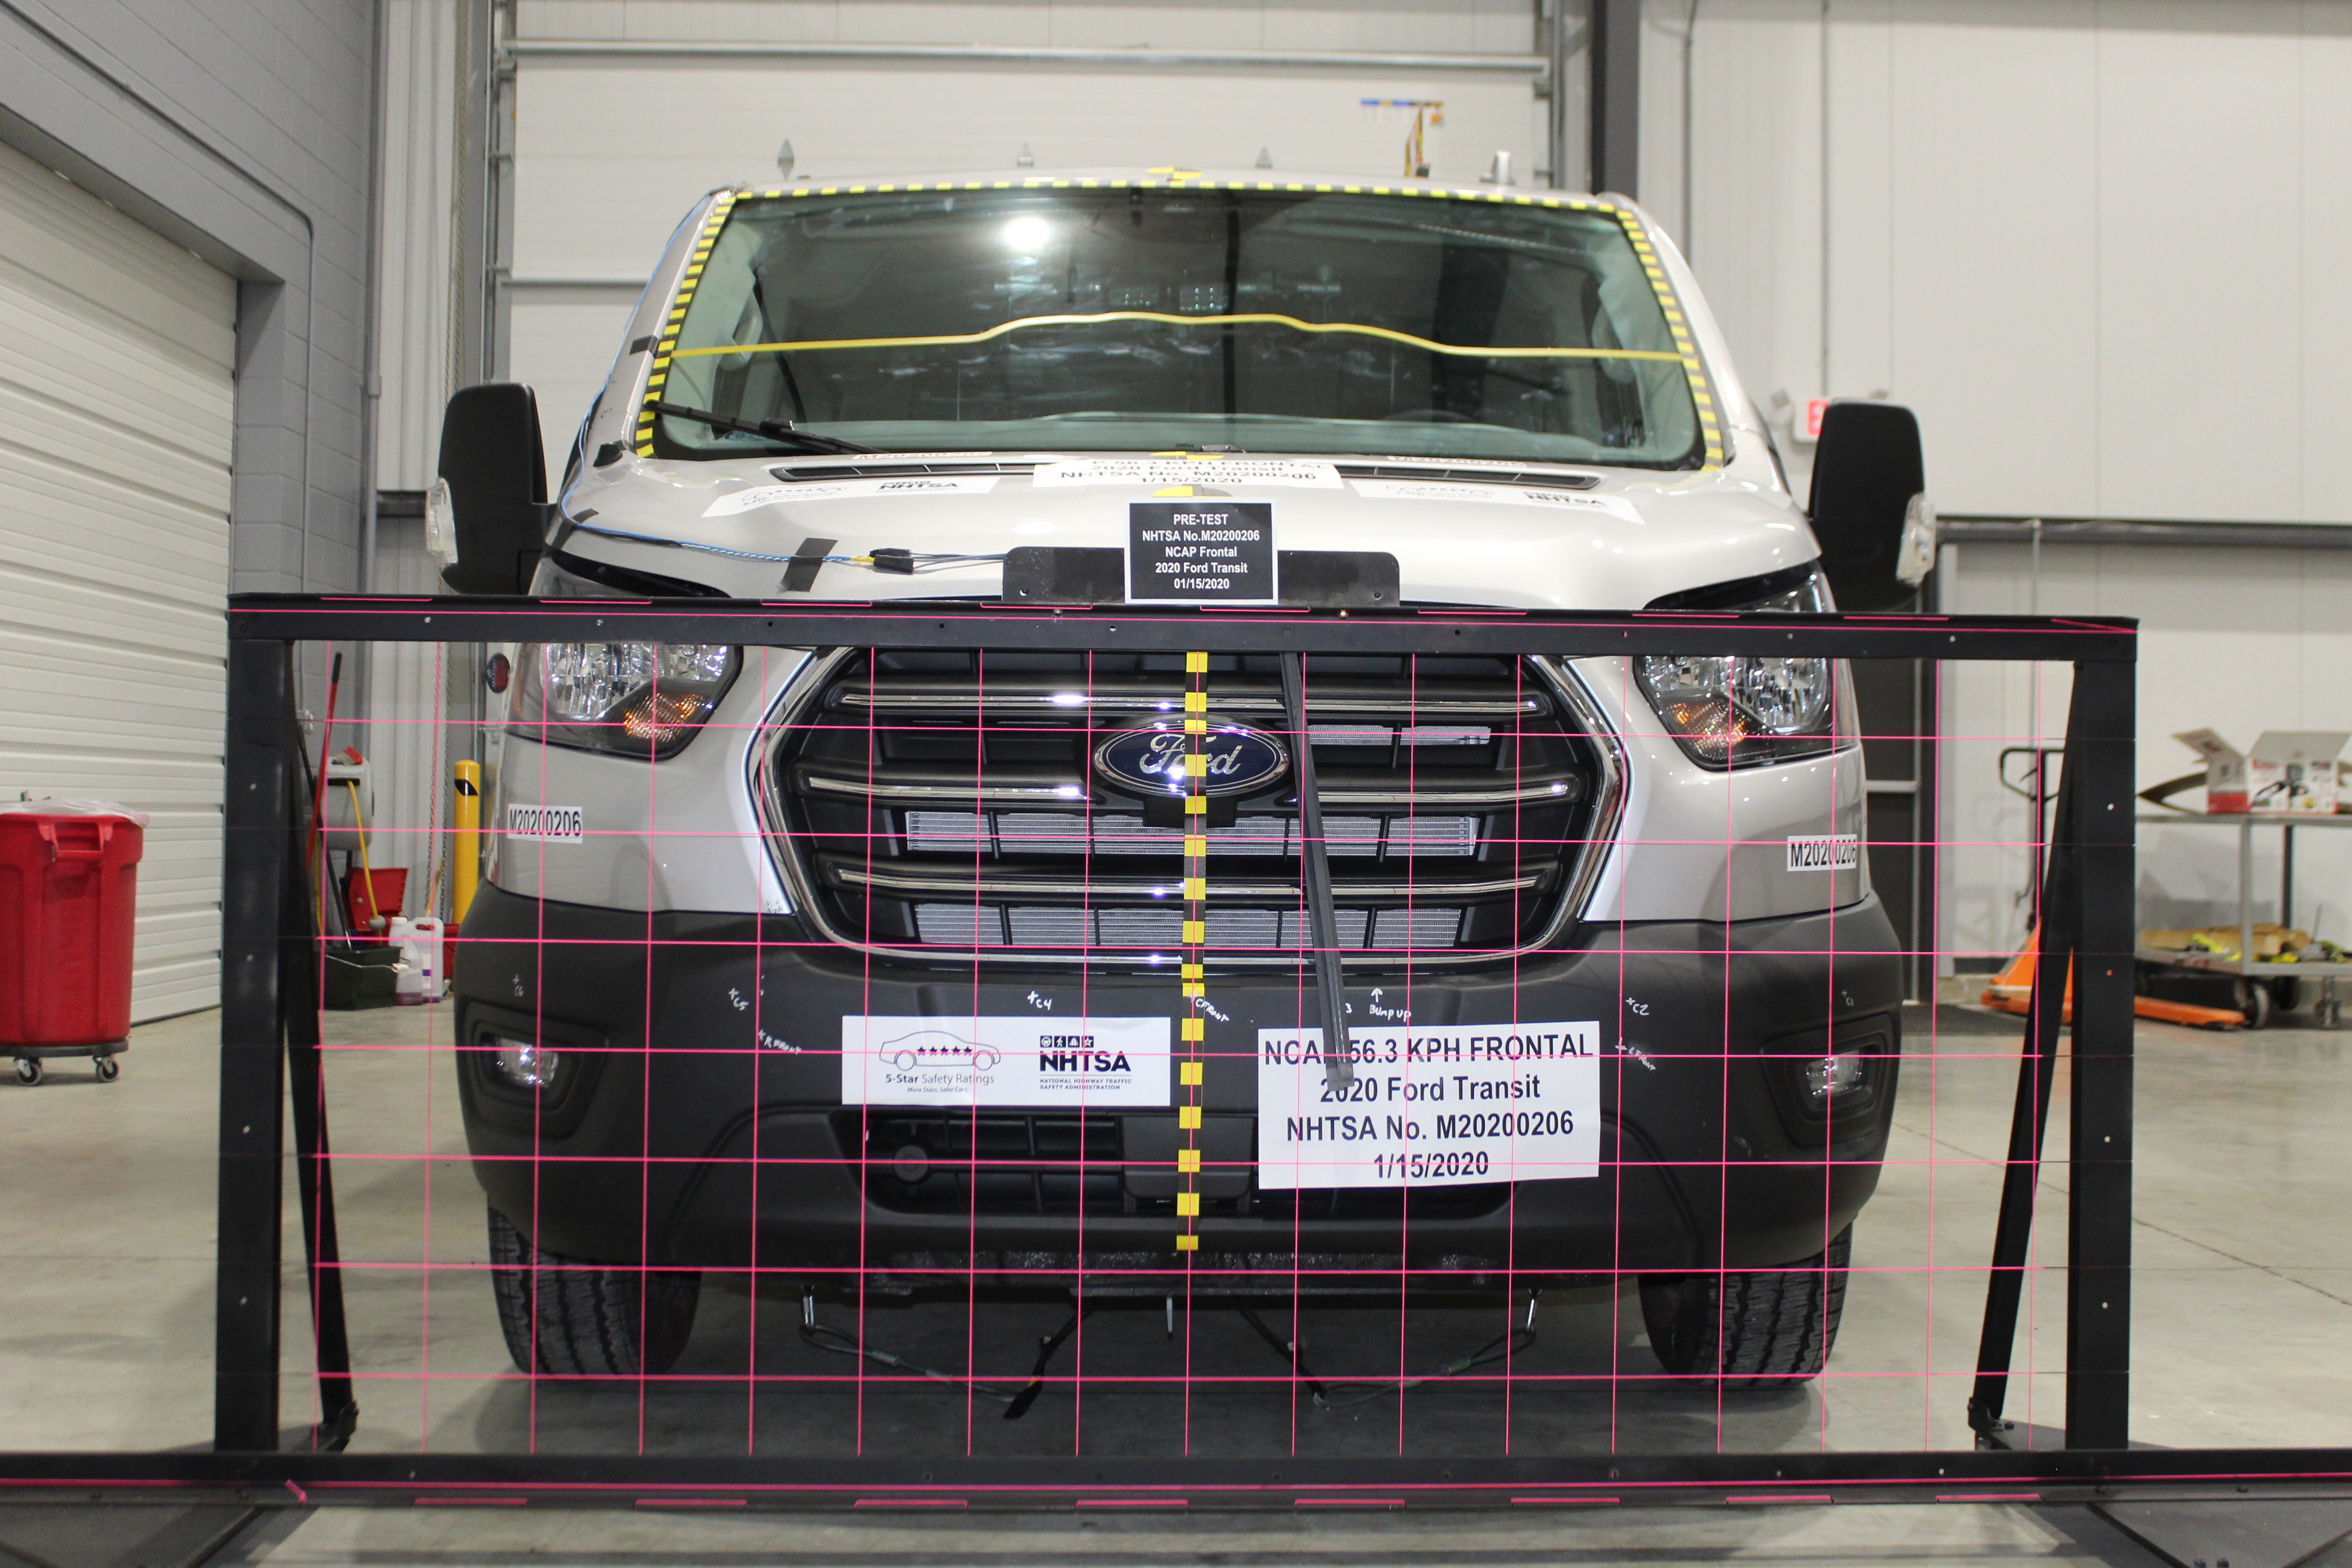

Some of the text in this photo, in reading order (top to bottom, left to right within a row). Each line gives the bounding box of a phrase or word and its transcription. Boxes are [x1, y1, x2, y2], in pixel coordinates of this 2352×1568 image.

[1194, 471, 1316, 480] M20200206
[1173, 514, 1228, 525] PRE-TEST
[1142, 529, 1260, 542] NHTSA No.M20200206
[1165, 546, 1237, 557] NCAP Frontal
[1156, 562, 1248, 573] 2020 Ford Transit
[1174, 578, 1230, 589] 01/15/2020
[510, 809, 581, 836] M20200206
[1791, 838, 1857, 867] M20200206
[1265, 1034, 1593, 1065] NCA 56.3 KPH FRONTAL
[1040, 1050, 1131, 1072] NHTSA
[885, 1074, 919, 1083] 5-Star
[921, 1073, 953, 1085] Safety
[1388, 1077, 1444, 1101] Ford
[1453, 1074, 1541, 1100] Transit
[1287, 1111, 1573, 1141] NHTSA No. M20200206
[1373, 1151, 1488, 1179] 1/15/2020
